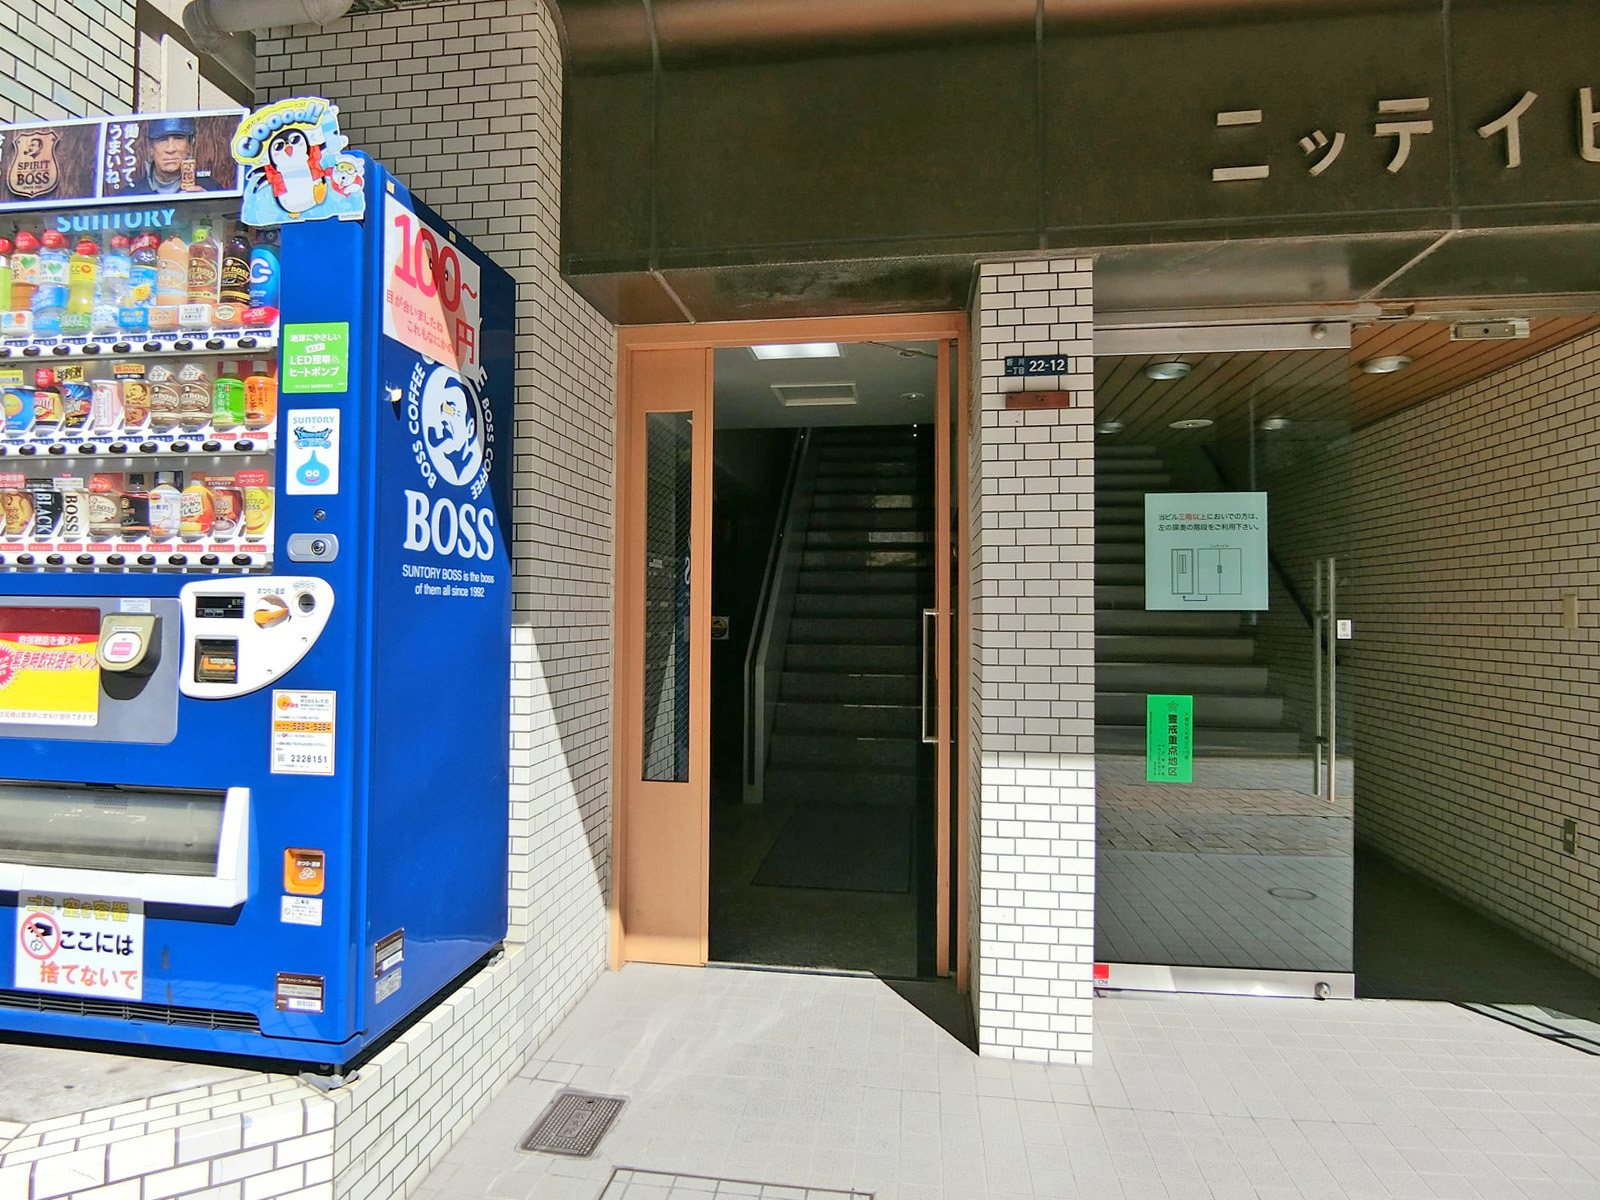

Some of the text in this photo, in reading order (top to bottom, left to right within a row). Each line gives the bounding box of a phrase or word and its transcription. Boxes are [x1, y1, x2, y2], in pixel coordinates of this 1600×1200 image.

[18, 161, 50, 171] SPIRIT
[105, 124, 122, 190] うまいね。
[16, 172, 50, 187] BOSS
[386, 289, 443, 334] 目が合いましたね
[290, 333, 342, 342] 地球にやさしい
[455, 318, 475, 365] 円
[290, 366, 340, 378] ヒートポンプ
[1029, 359, 1066, 373] 22-12
[407, 362, 426, 435] COFFEE
[293, 416, 335, 424] SUNTORY
[470, 397, 495, 500] BOSS COFFEE
[36, 492, 53, 534] BLACK
[65, 495, 78, 532] BOSS
[403, 489, 495, 561] BOSS
[402, 564, 495, 584] SUNTORY BOSS is the boss
[415, 583, 485, 598] of them all since 1992
[291, 755, 327, 763] 2228151
[60, 931, 134, 956] ここには
[40, 960, 138, 990] 捨てないで
